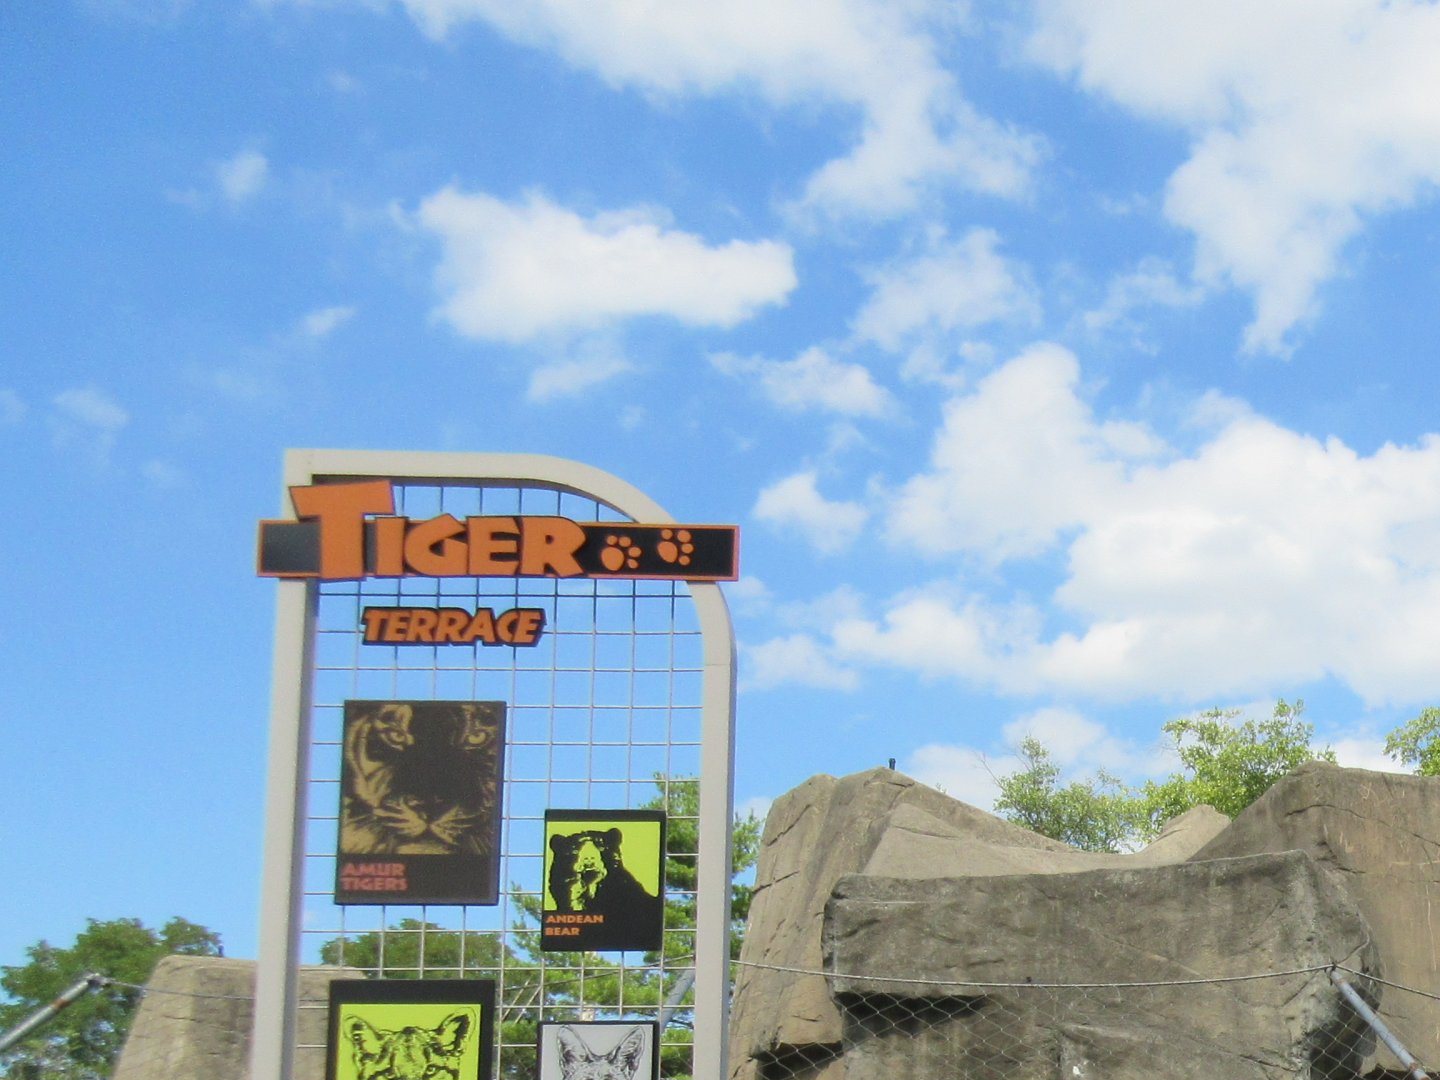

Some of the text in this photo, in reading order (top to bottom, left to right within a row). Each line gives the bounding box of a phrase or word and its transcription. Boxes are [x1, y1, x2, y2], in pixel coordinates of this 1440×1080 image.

[290, 481, 588, 580] TIGER
[363, 608, 545, 646] TERRACE
[341, 863, 406, 876] AMUR
[340, 877, 407, 891] TIGERS
[546, 915, 604, 924] ANDEAN
[545, 928, 580, 937] BEAR
